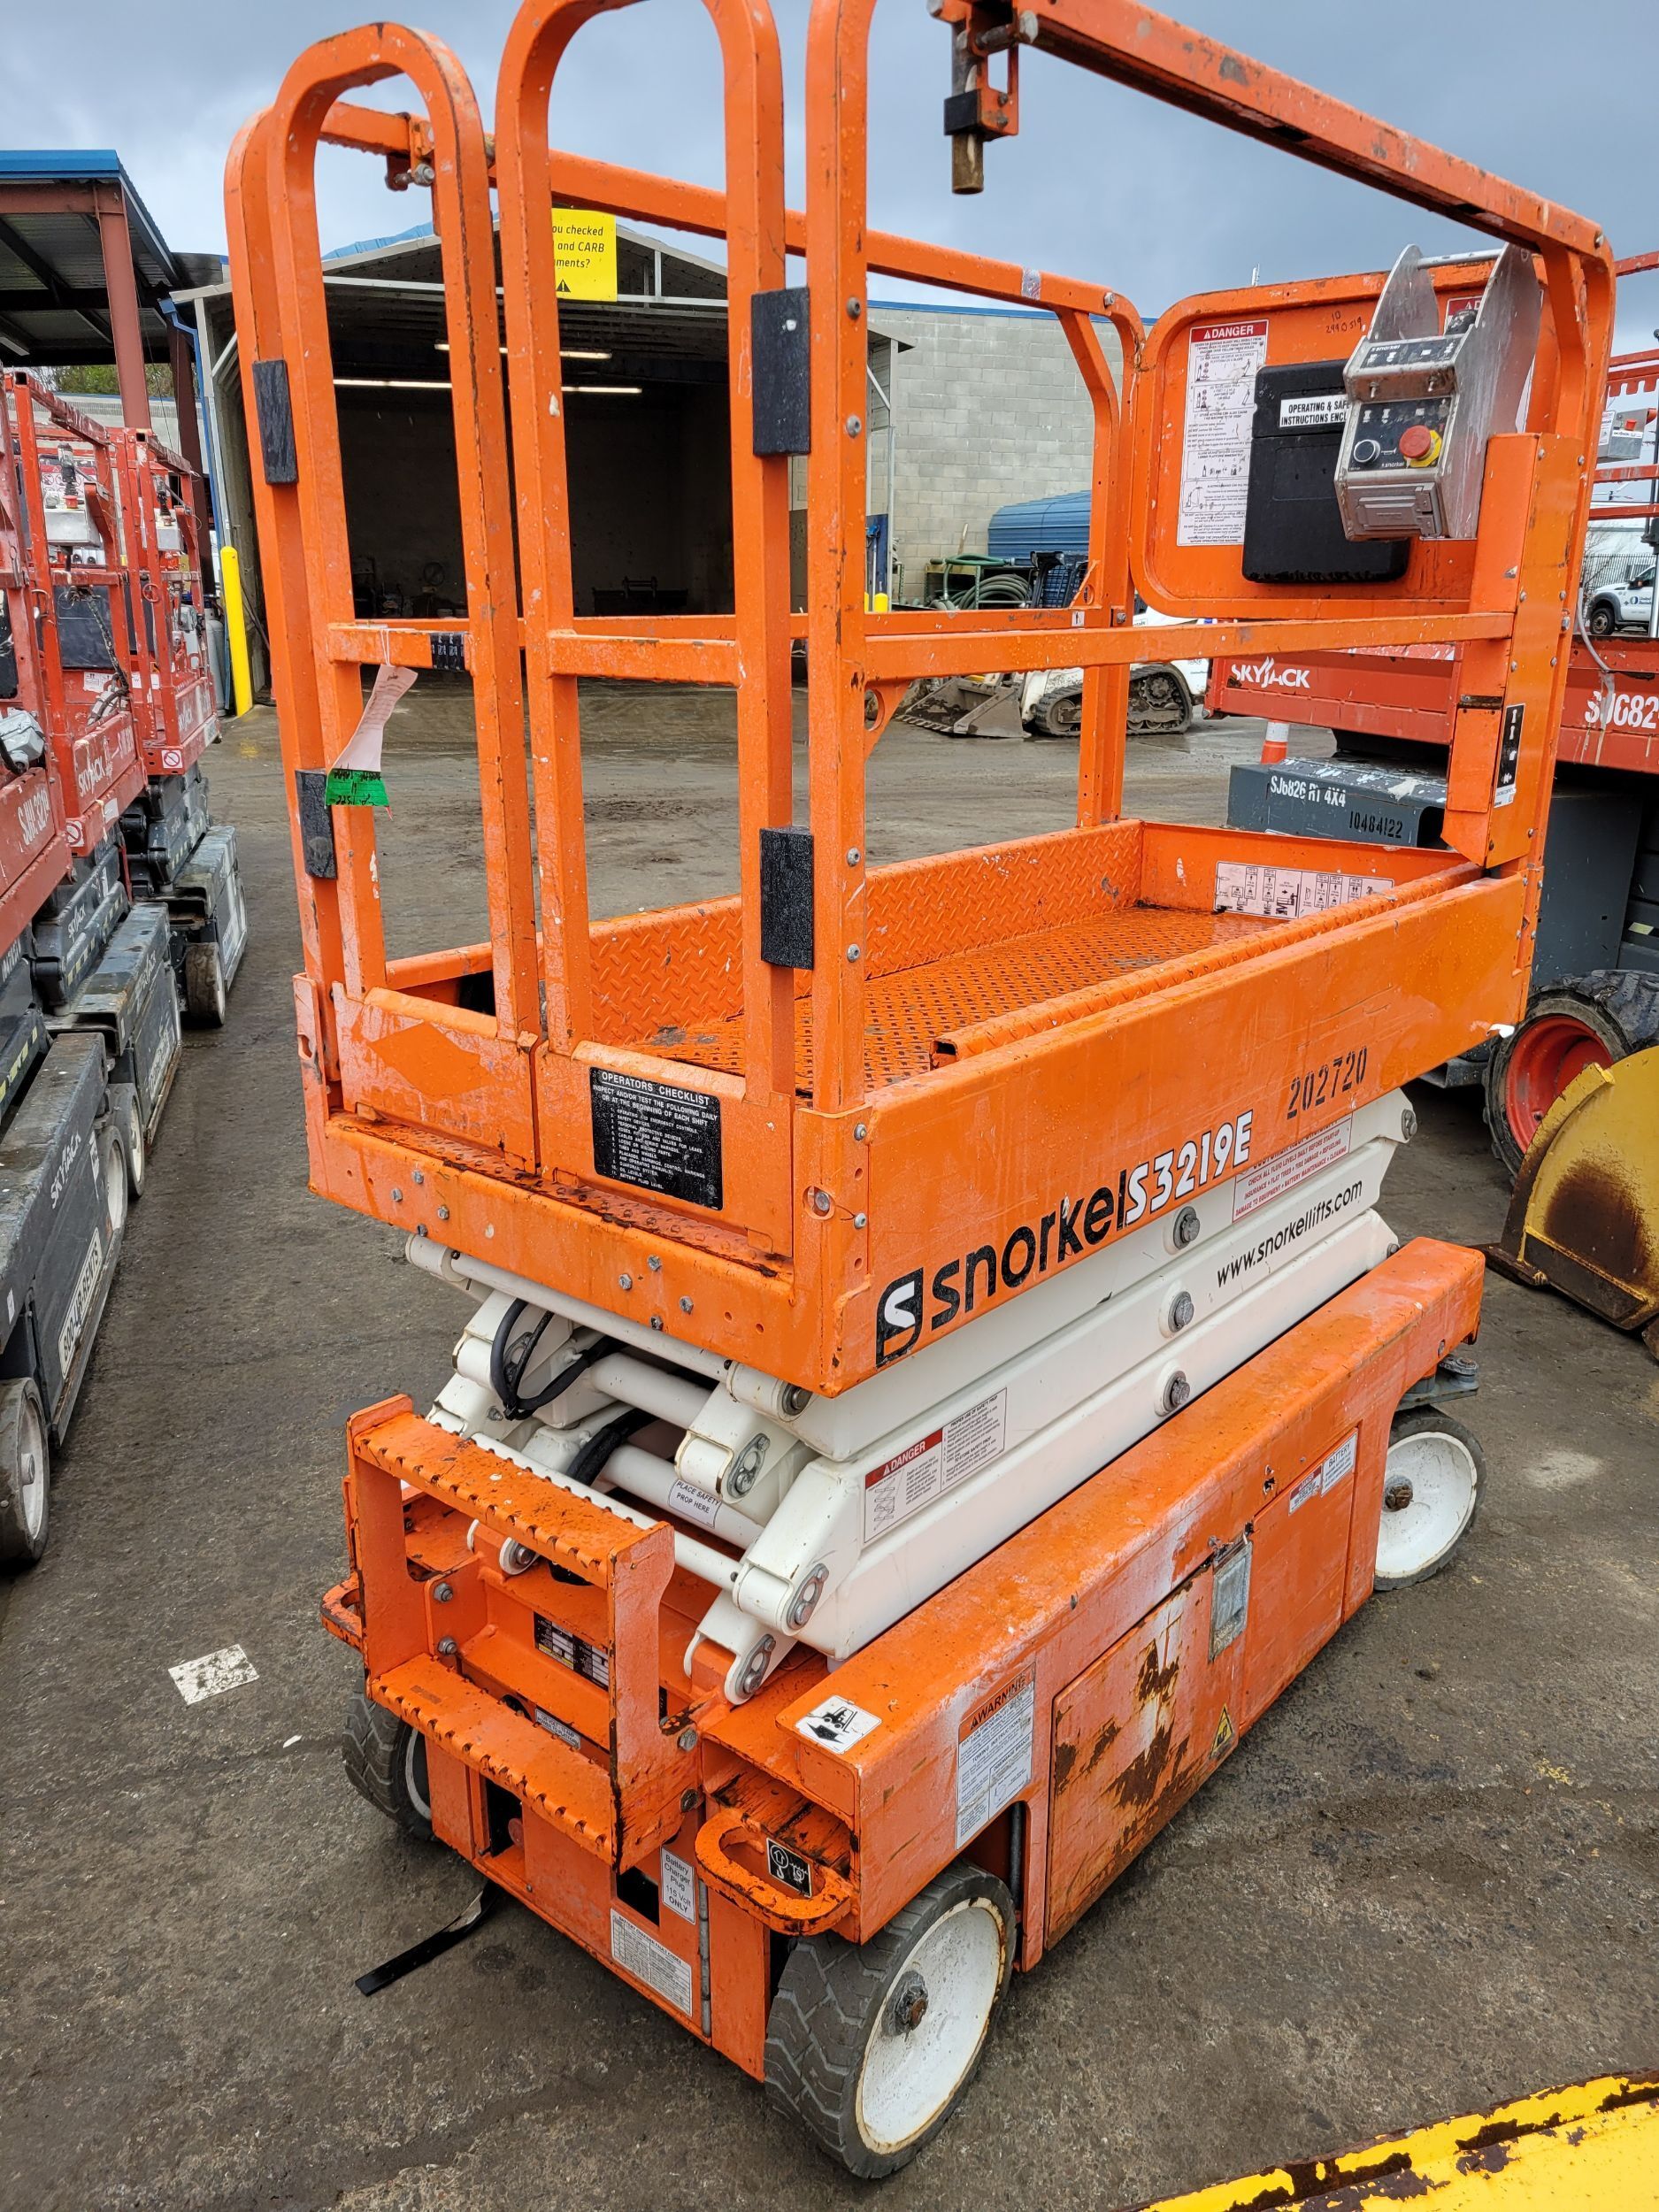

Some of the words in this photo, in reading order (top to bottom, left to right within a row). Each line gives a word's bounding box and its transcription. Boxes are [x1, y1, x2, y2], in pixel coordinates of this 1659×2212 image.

[566, 225, 603, 236] checked
[557, 242, 574, 250] and
[578, 242, 604, 253] CARB
[555, 258, 590, 268] ments?
[1211, 325, 1253, 339] DANGER
[1288, 402, 1325, 414] OPERATING
[1327, 401, 1332, 412] &
[1334, 400, 1350, 410] SAFE
[1280, 413, 1328, 426] INSTRUCTIONS
[1232, 656, 1310, 688] SKYJACK
[1324, 786, 1346, 808] 4X4
[1348, 810, 1403, 839] 10484122
[602, 1071, 653, 1091] OPERATORS
[659, 1086, 710, 1105] CHECKLIST
[1286, 1046, 1369, 1120] 202720
[593, 1085, 614, 1094] INSPECT
[616, 1090, 636, 1100] AND/OR
[638, 1095, 651, 1104] TEST
[666, 1102, 699, 1116] FOLLOWING
[702, 1111, 717, 1120] DAILY
[632, 1102, 662, 1114] BEGINNING
[692, 1118, 707, 1126] SHIFT
[1244, 1181, 1266, 1199] INSURANCE
[1280, 1167, 1291, 1178] TIRES
[1294, 1160, 1303, 1170] TIRE
[1304, 1151, 1318, 1164] DAMAGE
[1321, 1139, 1340, 1154] REFUELING
[1248, 1172, 1262, 1186] CHECK
[1271, 1162, 1282, 1172] FLUID
[1282, 1153, 1296, 1166] LEVELS
[1297, 1147, 1308, 1157] DAILY
[1309, 1139, 1322, 1151] BEFORE
[1323, 1129, 1339, 1143] START-UP
[1235, 1201, 1252, 1216] DAMAGE
[1258, 1184, 1280, 1202] EQUIPMENT
[1284, 1172, 1300, 1187] BATTERY
[1302, 1157, 1325, 1176] MAINTENANCE
[1329, 1145, 1346, 1159] CLEANING
[932, 1169, 1127, 1332] snorkel
[1125, 1109, 1254, 1226] S3219E
[1217, 1179, 1363, 1288] www.snorkellifts.com
[890, 1441, 926, 1473] DANGER
[1329, 1441, 1350, 1468] BATTERY
[677, 1481, 696, 1494] PLACE
[697, 1491, 720, 1506] SAFETY
[677, 1493, 693, 1504] PROP
[694, 1501, 710, 1513] HERE
[978, 1674, 1025, 1723] WARNING
[664, 1863, 690, 1886] Charger
[665, 1855, 689, 1875] Battery
[665, 1885, 678, 1898] 115
[678, 1891, 691, 1907] Volt
[670, 1876, 686, 1892] Plug
[669, 1896, 688, 1914] ONLY
